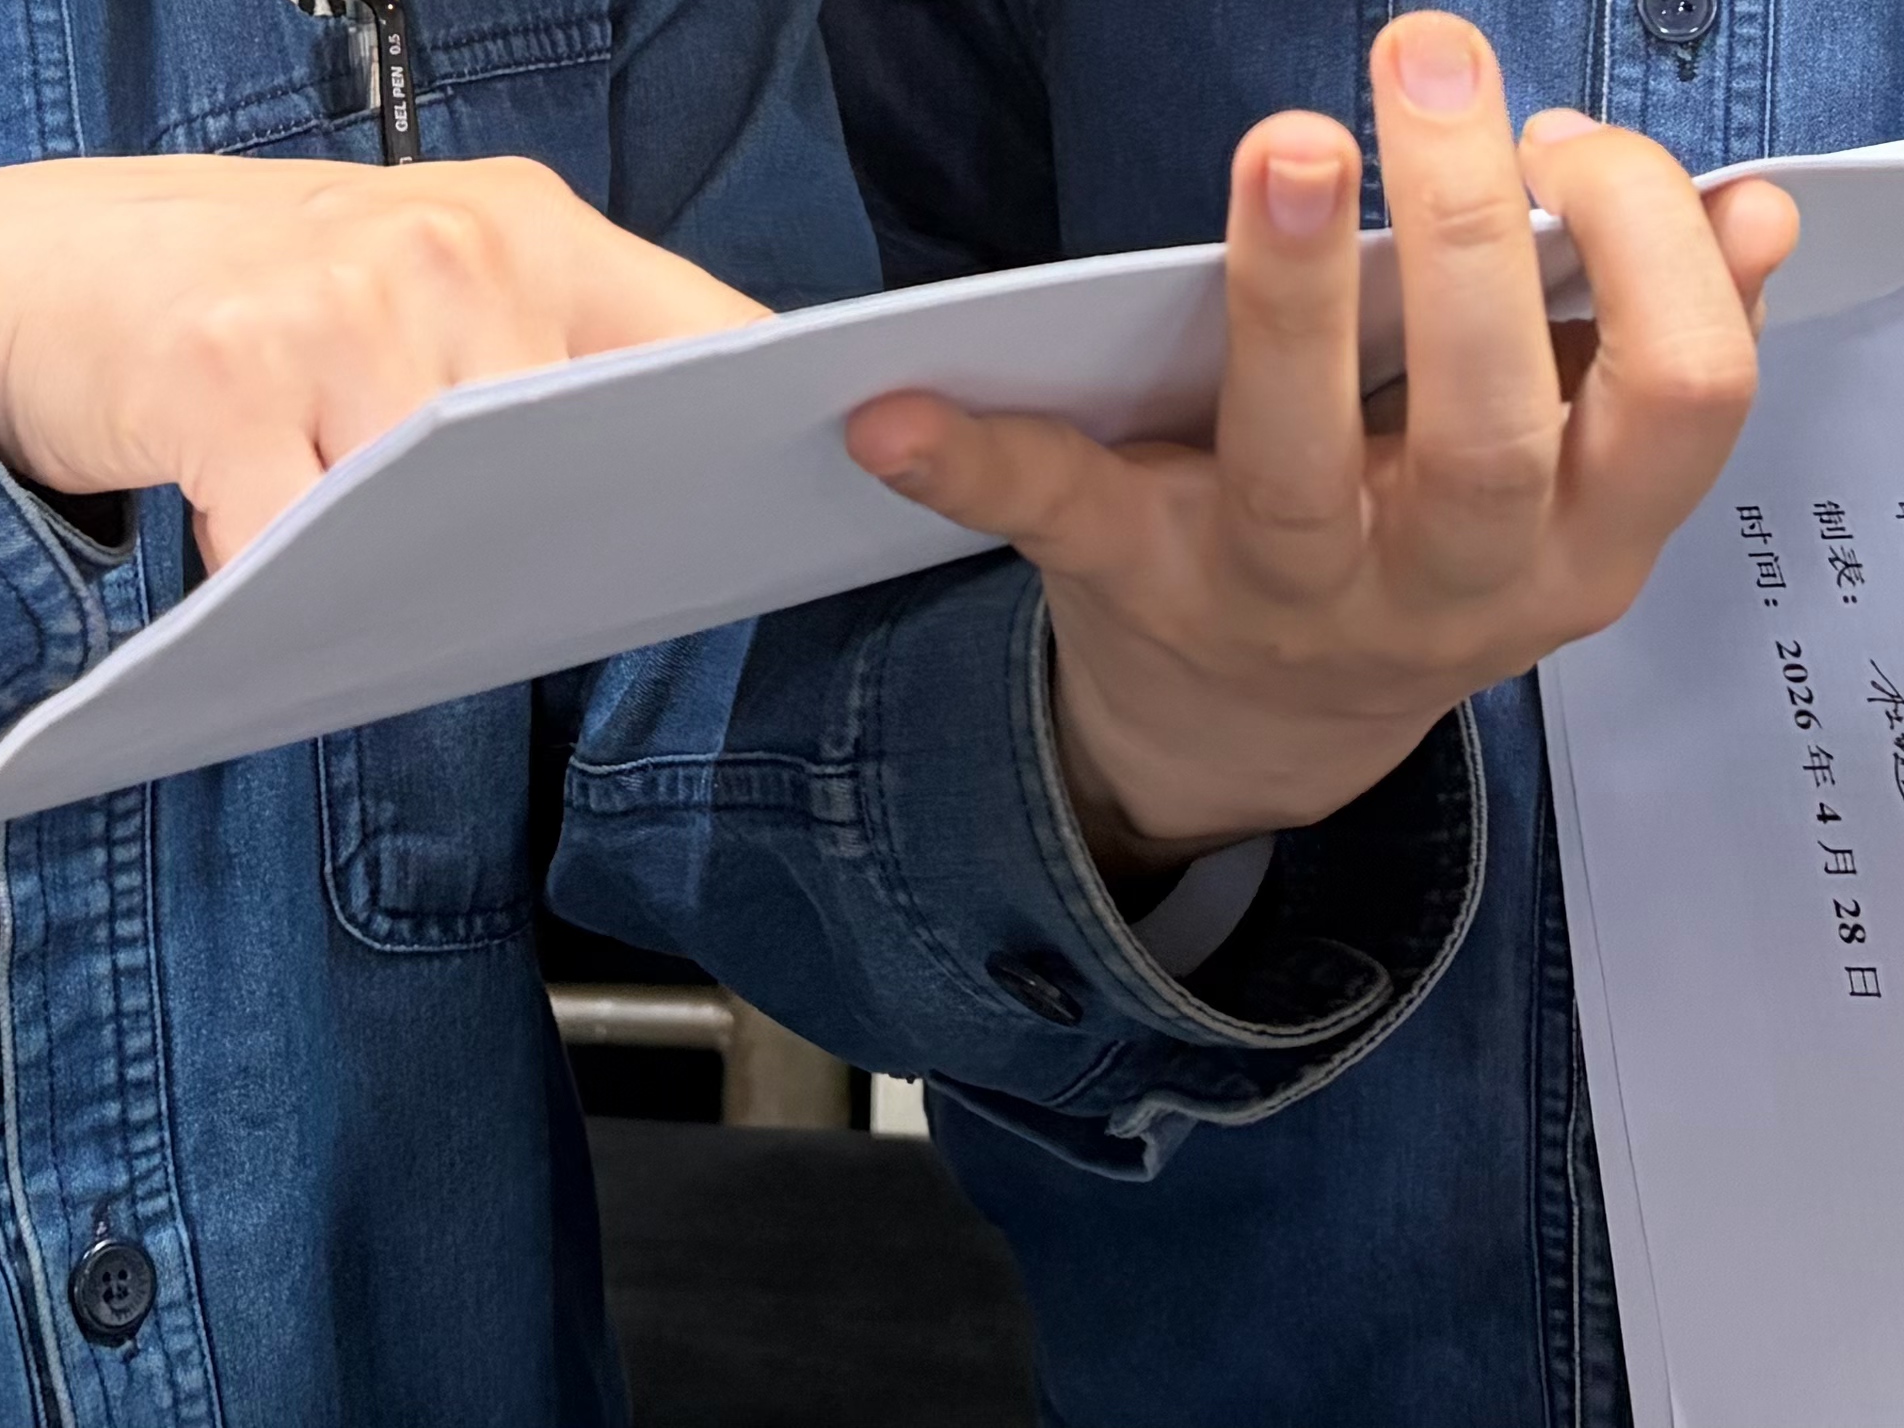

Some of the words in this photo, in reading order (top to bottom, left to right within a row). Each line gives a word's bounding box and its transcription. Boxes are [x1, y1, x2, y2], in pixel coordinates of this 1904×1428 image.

[390, 66, 405, 98] PEN
[395, 101, 409, 132] GEL
[1812, 500, 1865, 606] 制表：
[1775, 638, 1822, 732] 2026
